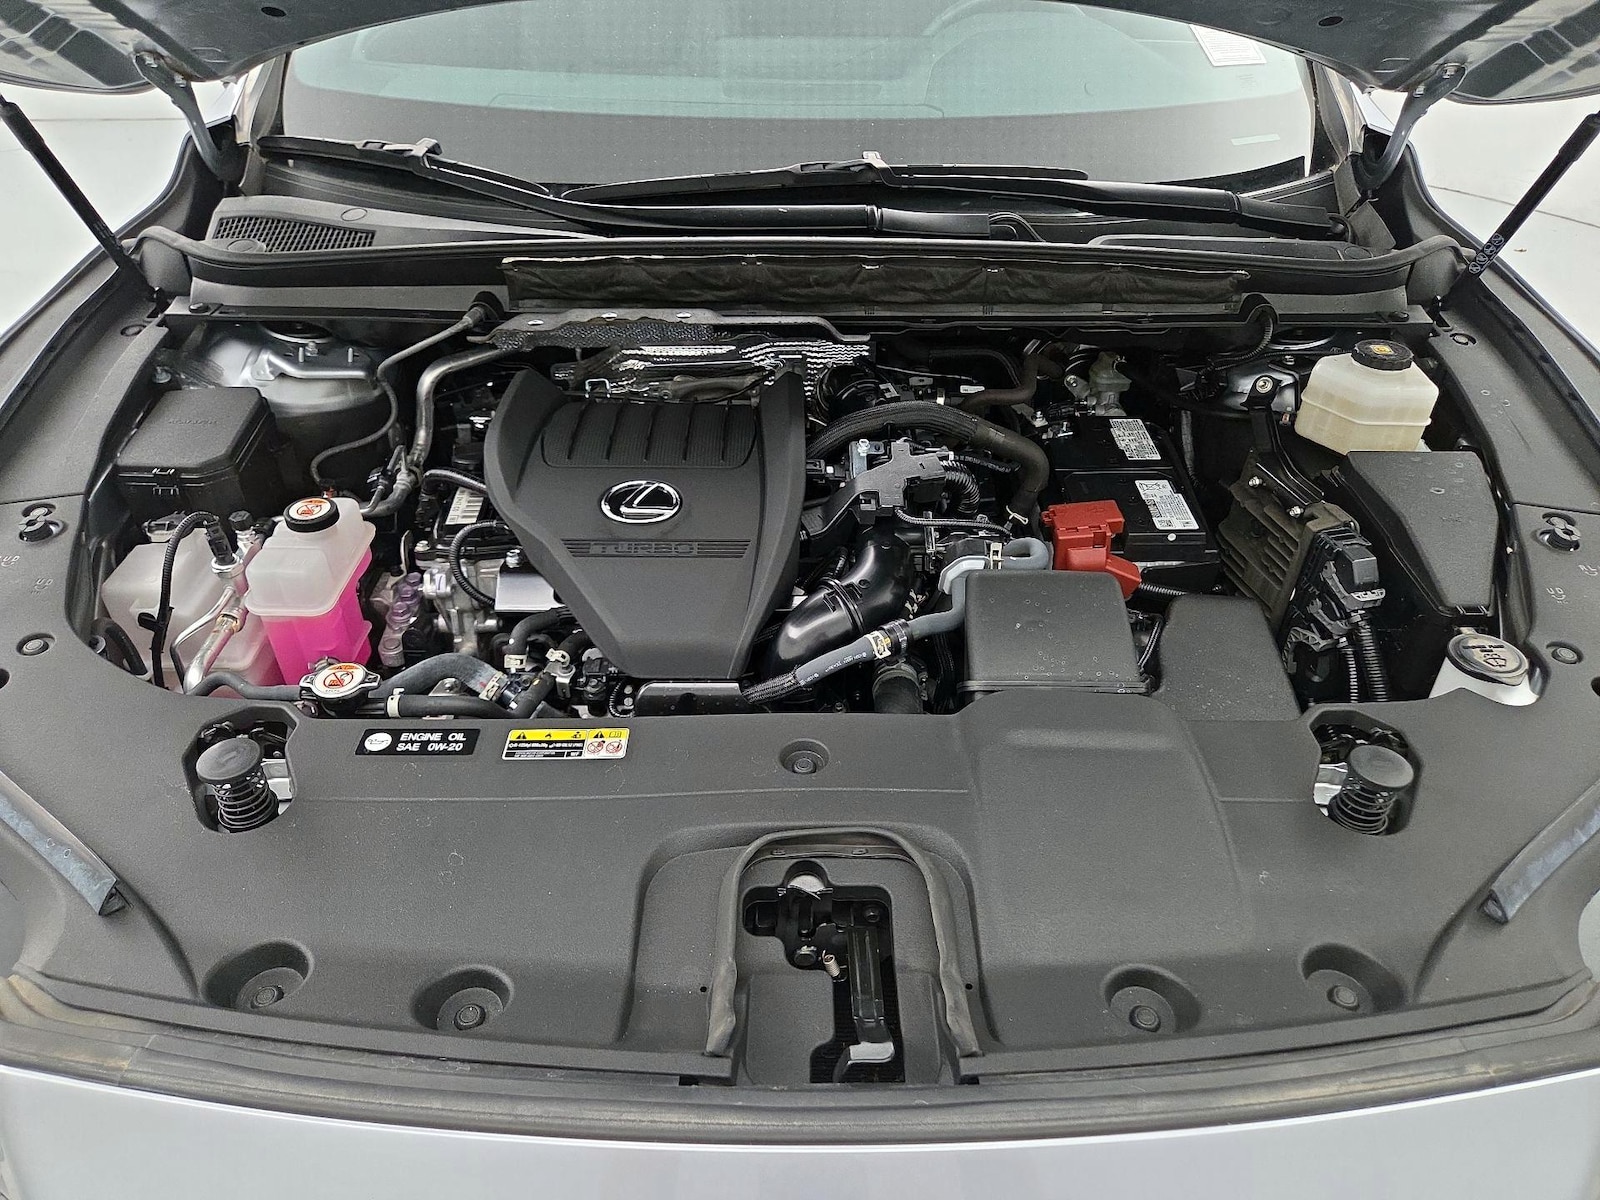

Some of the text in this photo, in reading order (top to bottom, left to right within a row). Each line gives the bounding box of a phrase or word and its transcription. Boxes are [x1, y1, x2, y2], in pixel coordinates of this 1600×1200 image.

[591, 541, 696, 555] TURBO
[400, 732, 467, 742] ENGINE OIL
[395, 742, 464, 752] SAE 0W-20
